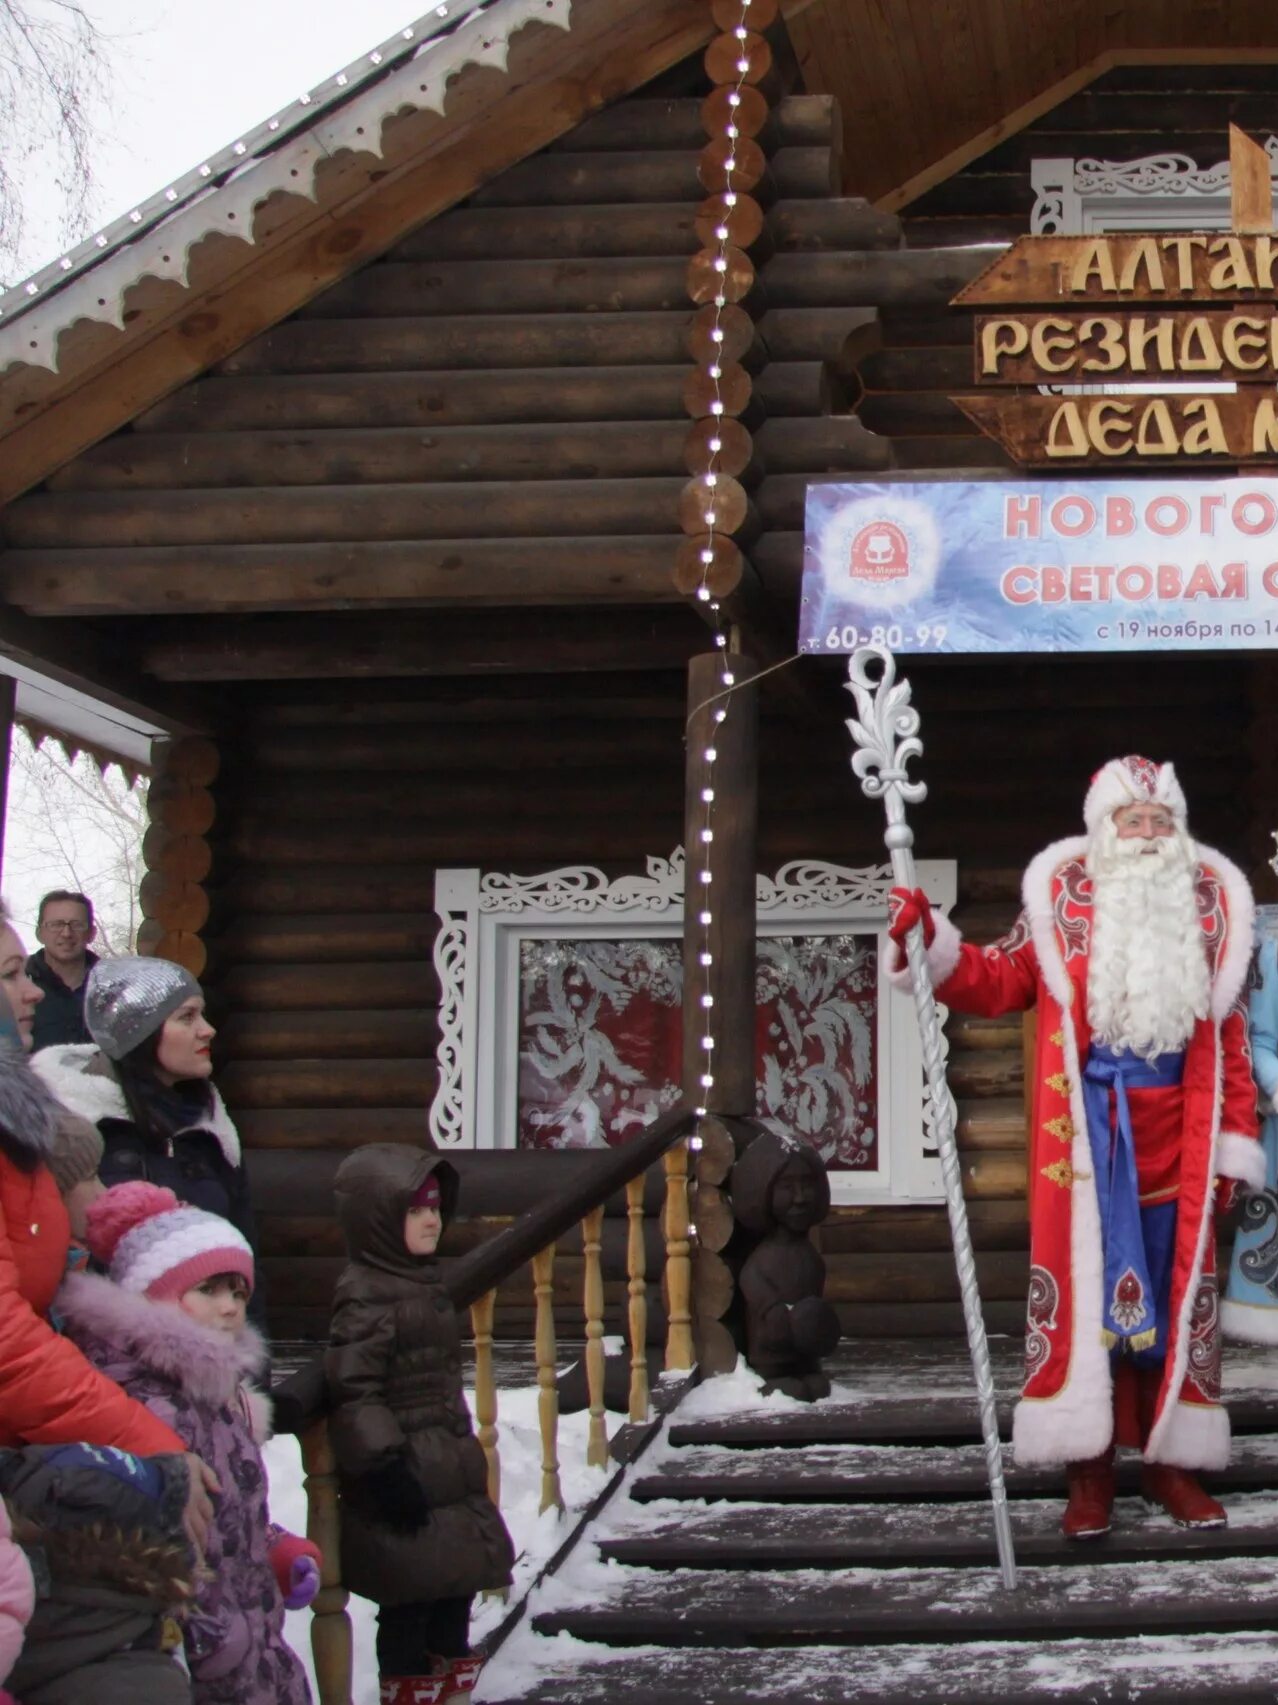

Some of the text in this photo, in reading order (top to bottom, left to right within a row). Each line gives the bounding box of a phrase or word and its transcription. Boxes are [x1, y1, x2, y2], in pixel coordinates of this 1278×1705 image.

[1044, 398, 1230, 457] ДЕДА
[1002, 561, 1249, 604] СВЕТОВАЯ
[825, 625, 948, 649] 60-80-99
[1097, 626, 1109, 639] с
[1118, 622, 1140, 639] 19
[1147, 620, 1223, 641] ноября
[1230, 623, 1256, 637] по
